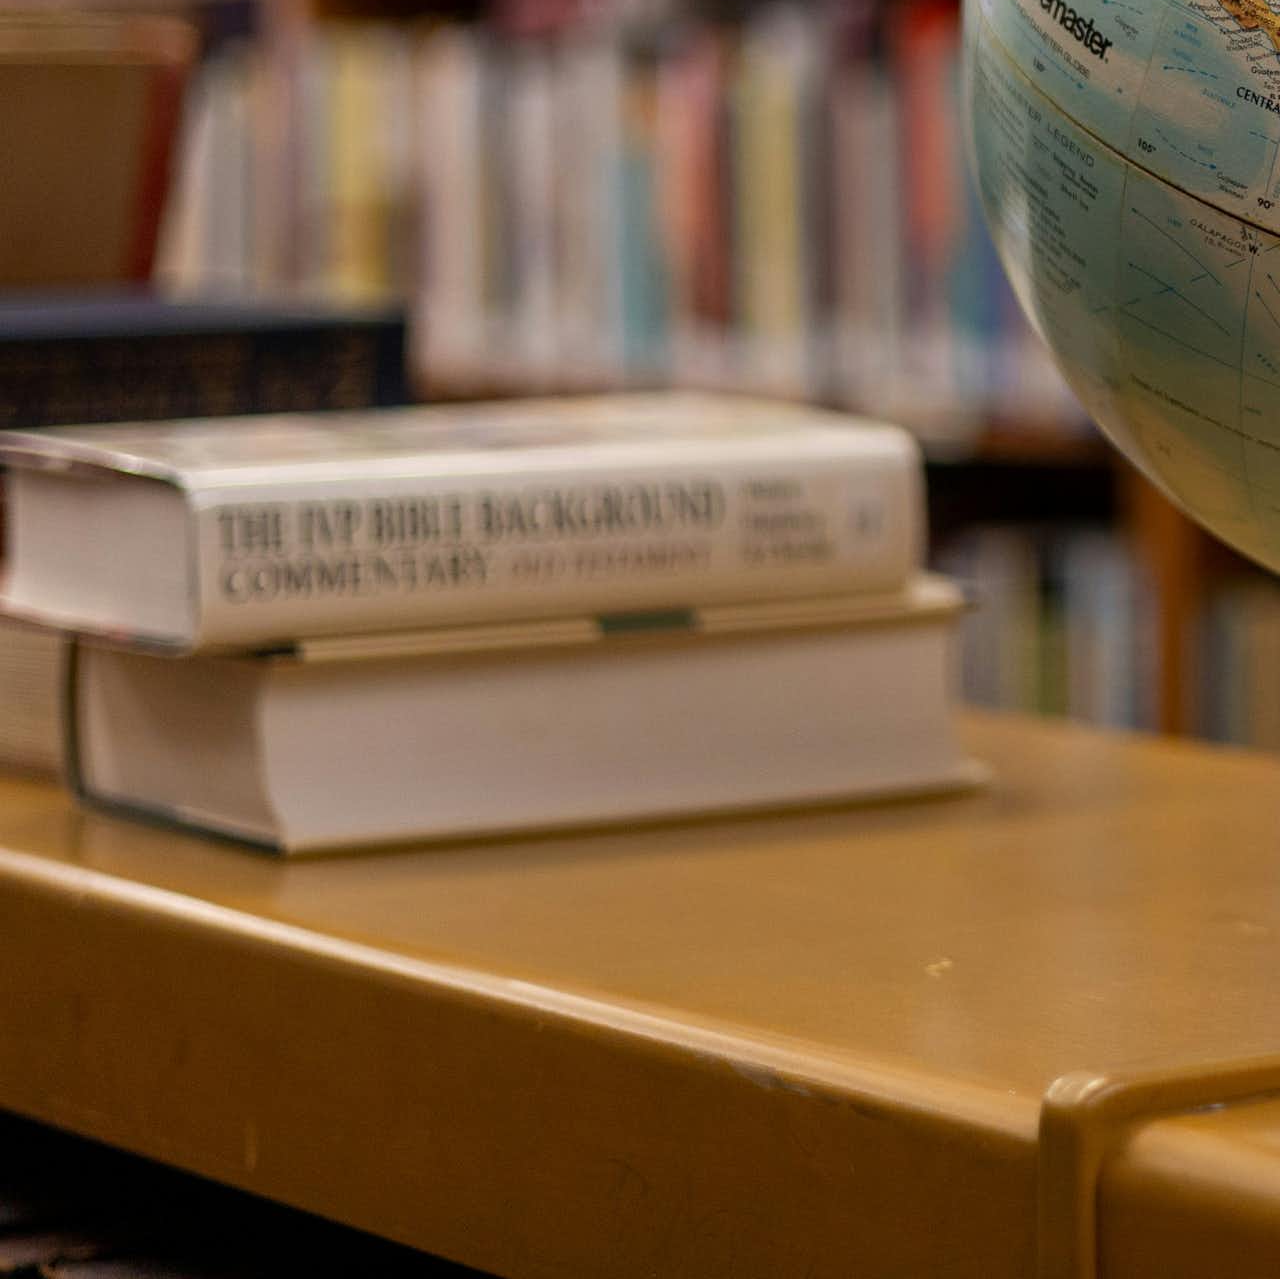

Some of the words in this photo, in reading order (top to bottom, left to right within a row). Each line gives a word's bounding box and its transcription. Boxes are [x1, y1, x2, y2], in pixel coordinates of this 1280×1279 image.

[1046, 121, 1095, 168] LEGEND
[1256, 197, 1276, 210] 90°
[218, 505, 283, 550] THE
[299, 501, 361, 545] IVP
[371, 494, 464, 542] BIBLE
[477, 478, 726, 537] BACKGROUND
[220, 548, 488, 604] COMMENTARY
